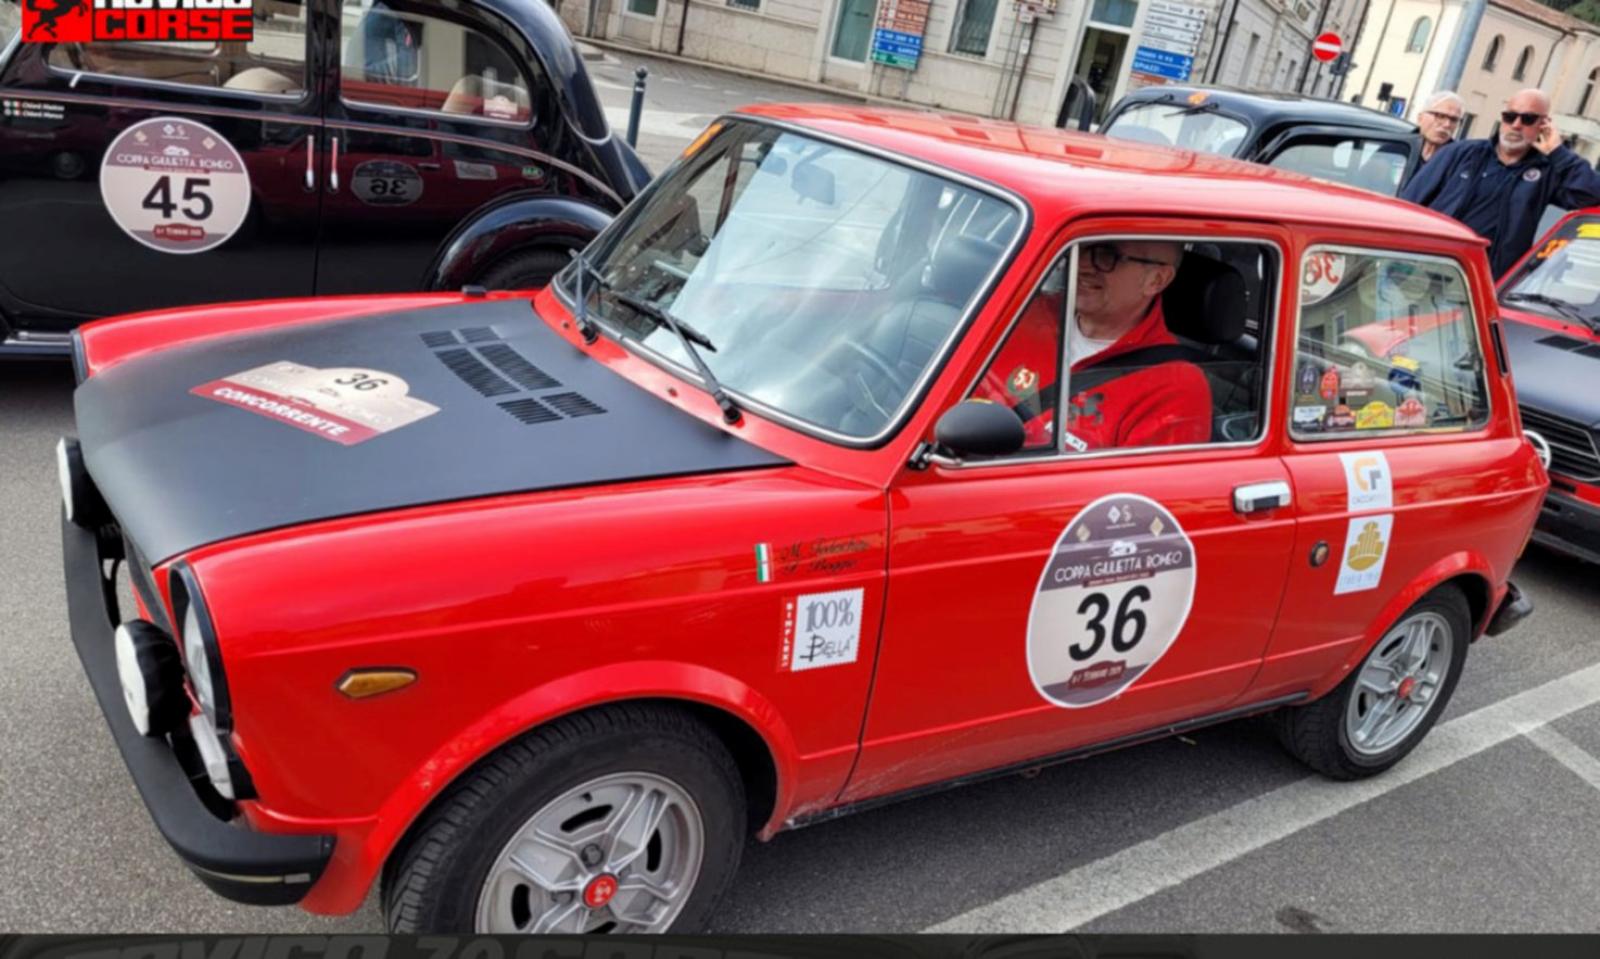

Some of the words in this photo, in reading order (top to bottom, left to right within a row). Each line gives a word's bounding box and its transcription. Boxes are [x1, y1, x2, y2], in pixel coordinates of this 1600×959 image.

[116, 154, 150, 165] COPPA
[199, 158, 233, 170] ROMEO
[141, 175, 214, 221] 45
[334, 373, 389, 392] 36
[213, 387, 350, 437] CONCORRENTE
[1055, 564, 1091, 582] COPPA
[1093, 557, 1142, 576] GIULIETTA
[1146, 551, 1183, 569] ROMEO
[806, 597, 854, 632] 100%
[1068, 585, 1151, 661] 36
